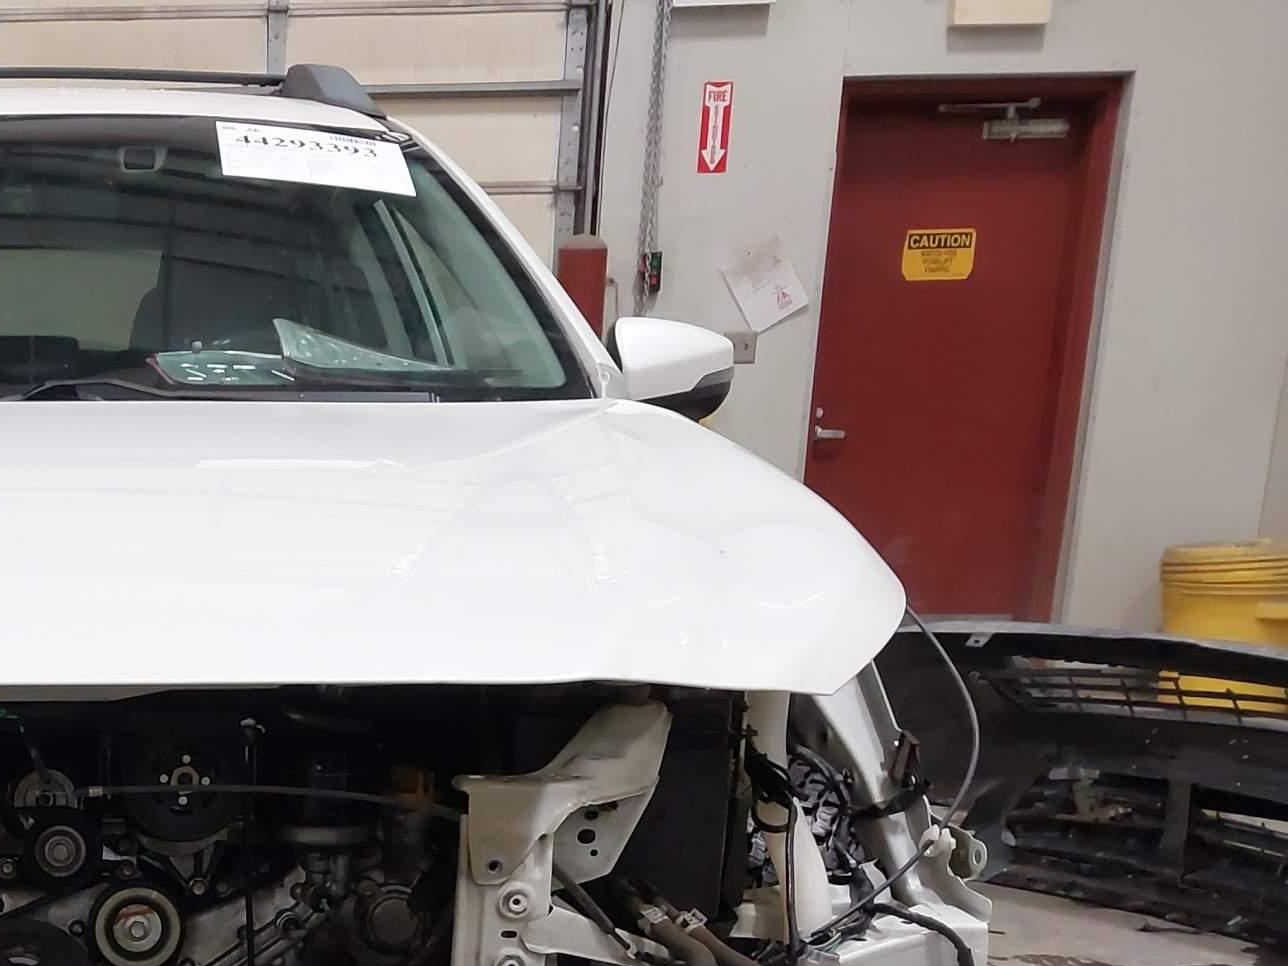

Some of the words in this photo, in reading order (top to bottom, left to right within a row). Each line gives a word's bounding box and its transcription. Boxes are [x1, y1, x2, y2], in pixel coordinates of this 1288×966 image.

[708, 90, 728, 102] FIRE
[235, 134, 377, 158] 44293393
[910, 234, 971, 248] CAUTION
